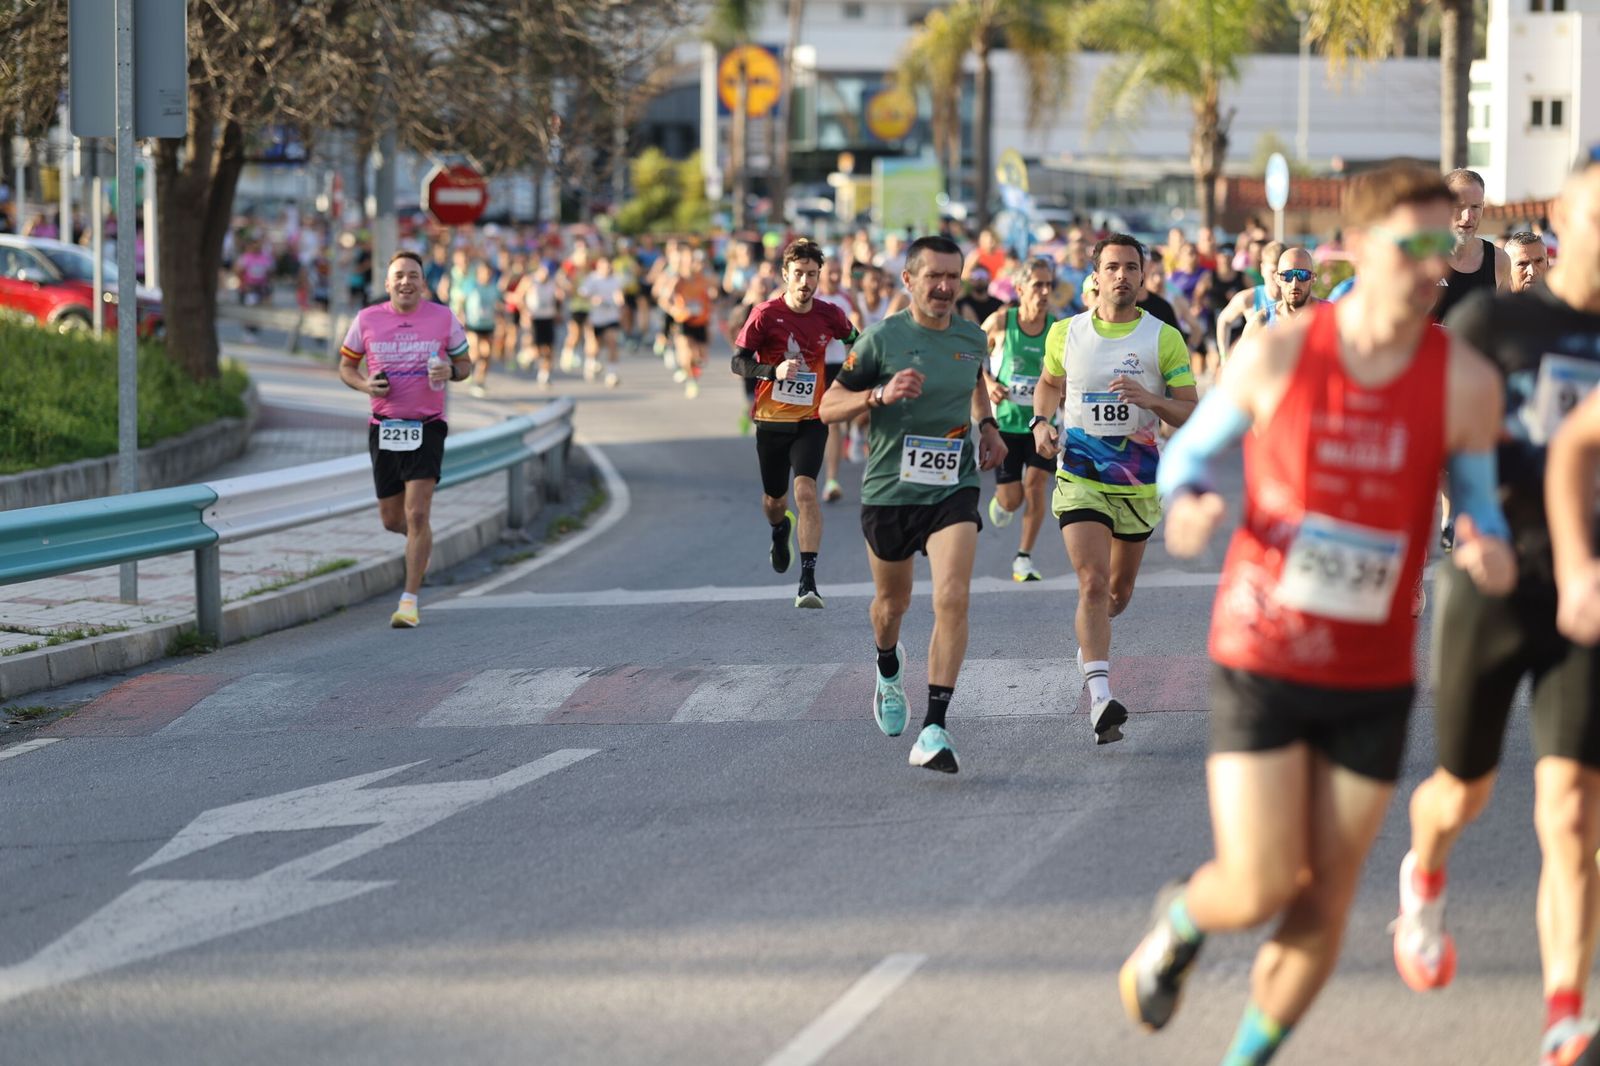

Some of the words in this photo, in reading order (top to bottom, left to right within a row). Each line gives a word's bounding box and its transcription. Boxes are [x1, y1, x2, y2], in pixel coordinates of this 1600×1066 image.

[777, 380, 814, 395] 1793
[1012, 385, 1036, 397] 124
[1091, 404, 1130, 422] 188
[382, 428, 420, 441] 2218
[907, 449, 958, 470] 1265
